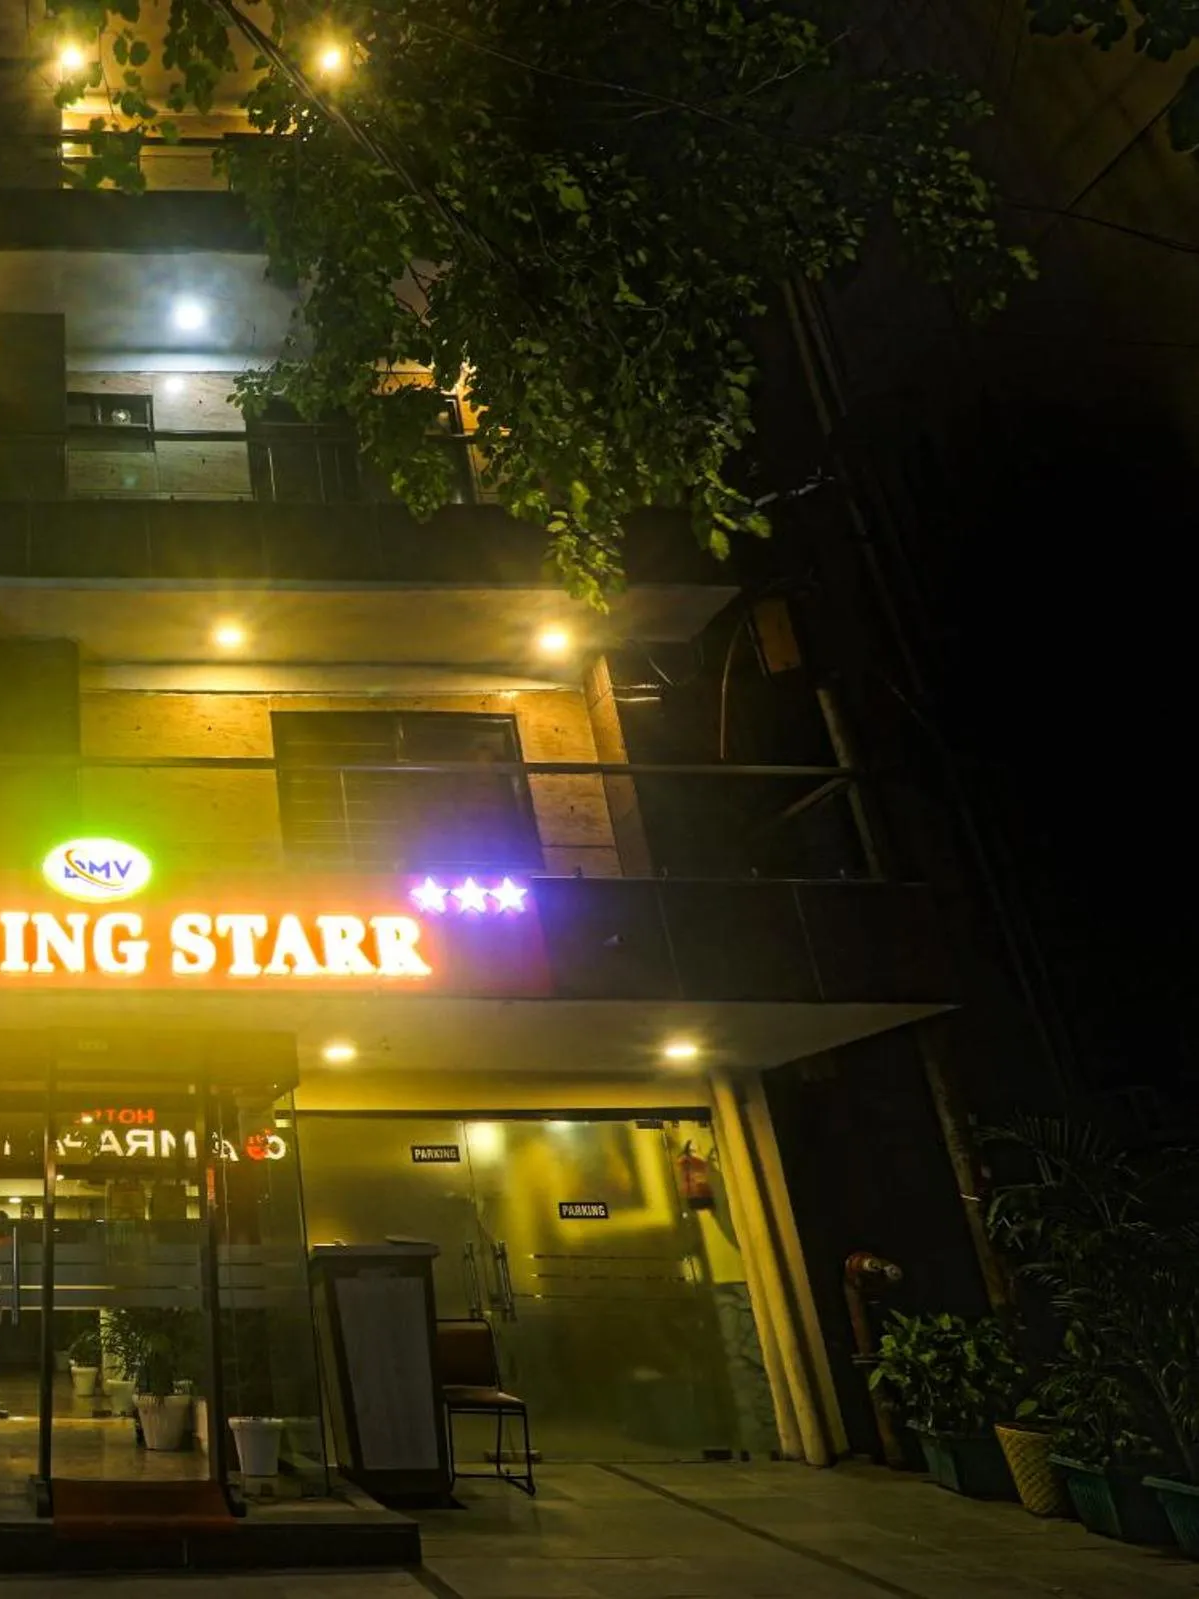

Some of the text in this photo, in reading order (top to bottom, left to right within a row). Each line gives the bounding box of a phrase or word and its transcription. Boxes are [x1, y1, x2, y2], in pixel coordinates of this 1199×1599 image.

[169, 911, 433, 977] STARR
[413, 1147, 458, 1160] PARKING
[561, 1203, 607, 1218] PARKING
